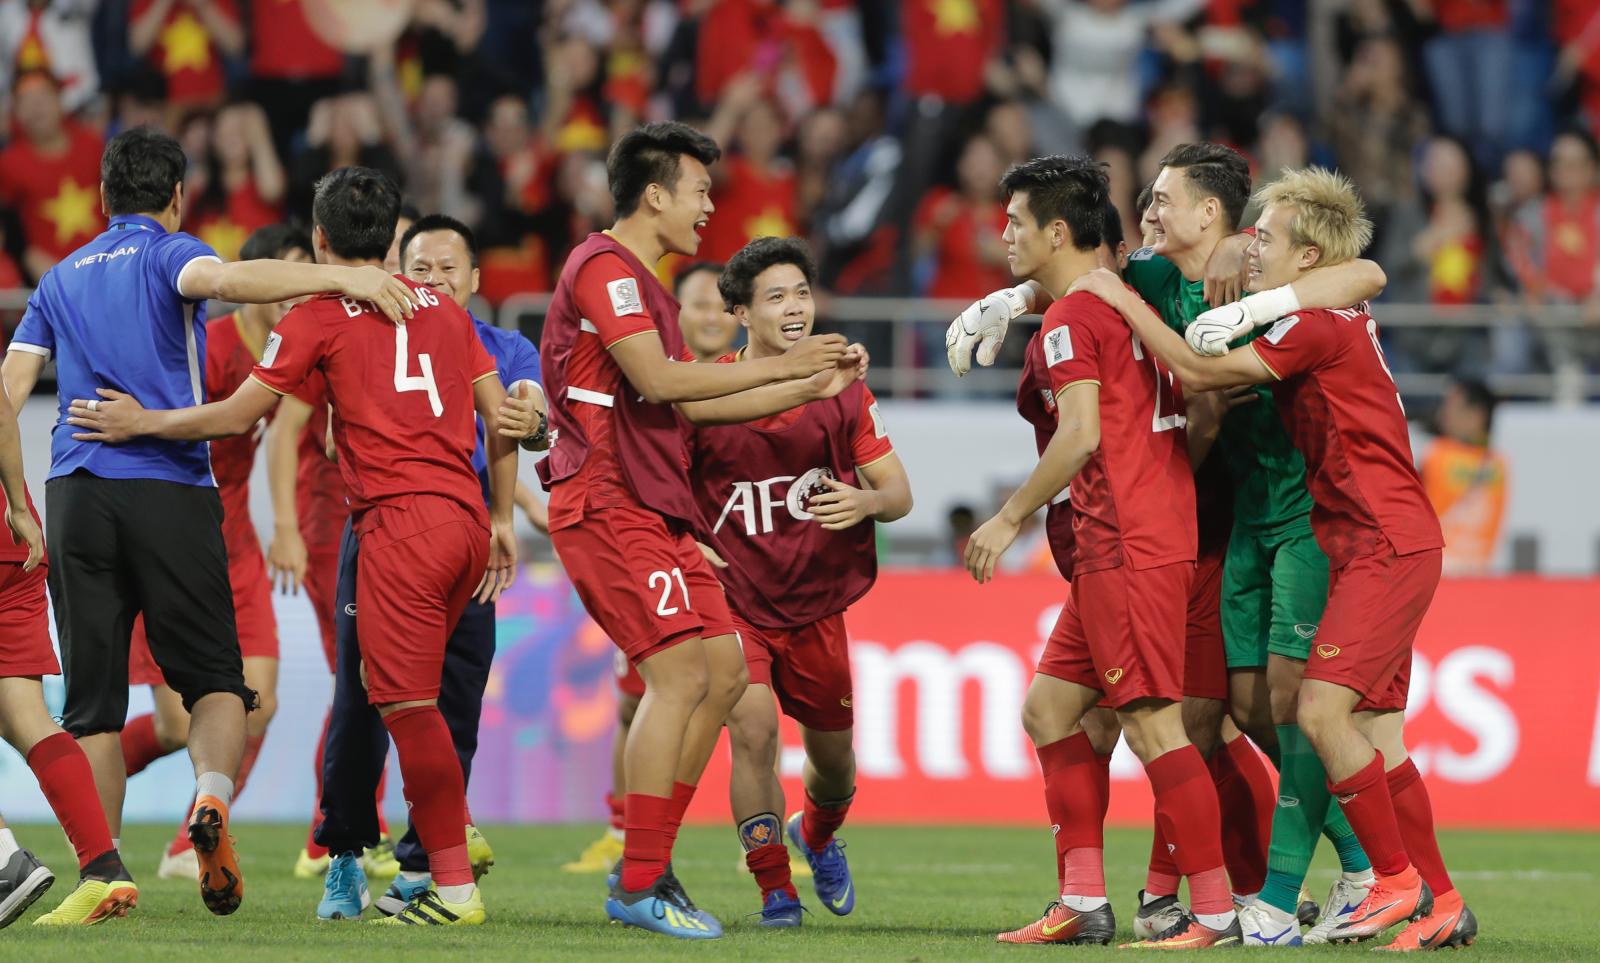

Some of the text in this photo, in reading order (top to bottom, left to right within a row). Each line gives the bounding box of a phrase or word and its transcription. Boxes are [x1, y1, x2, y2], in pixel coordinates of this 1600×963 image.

[74, 246, 139, 269] VIETNAM
[393, 320, 444, 417] 4
[648, 567, 690, 616] 21
